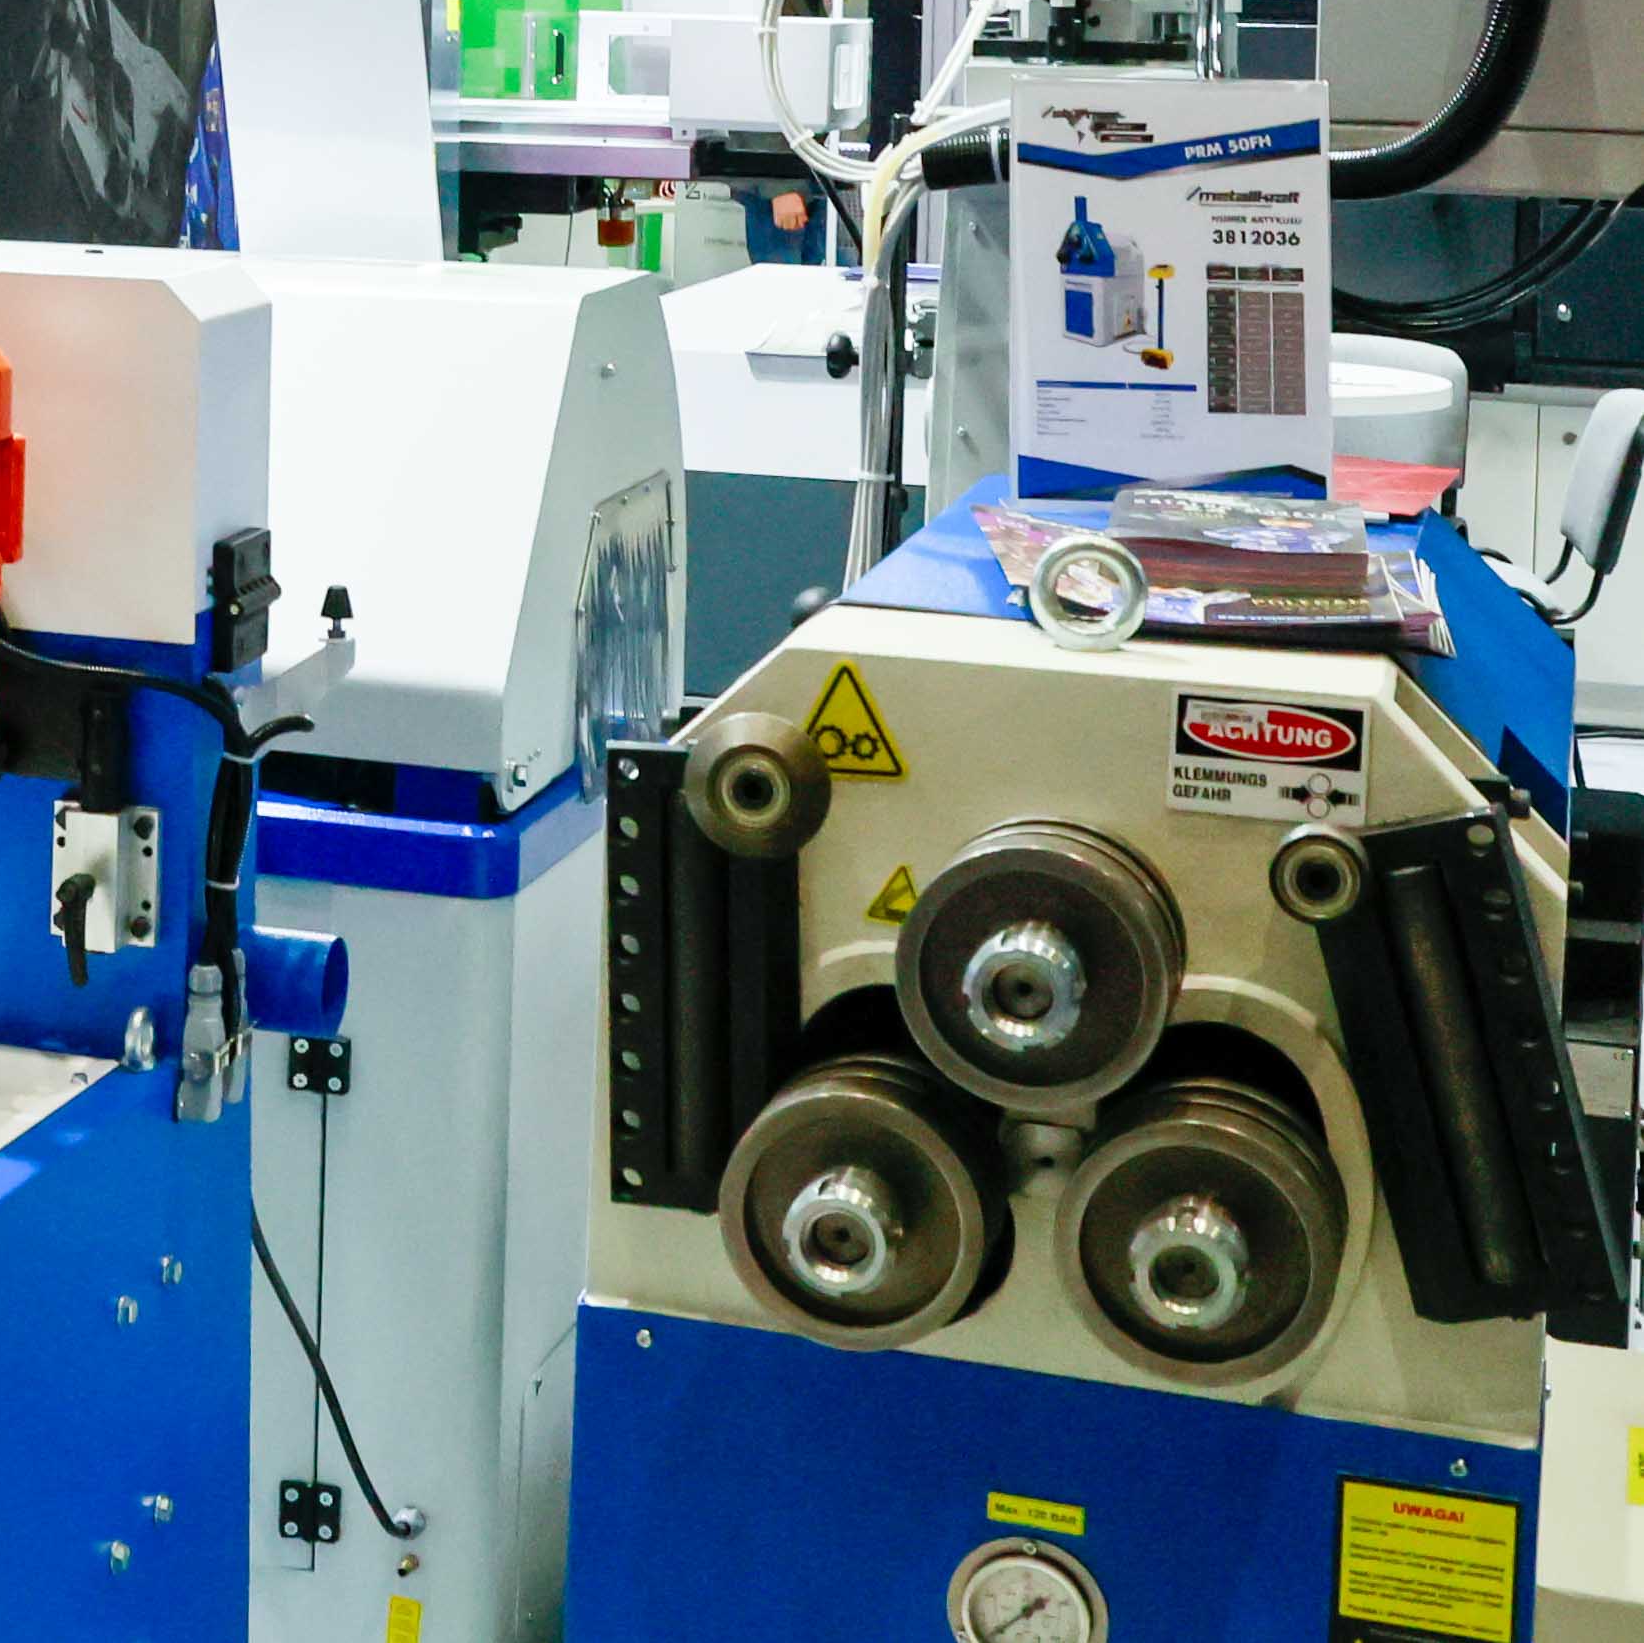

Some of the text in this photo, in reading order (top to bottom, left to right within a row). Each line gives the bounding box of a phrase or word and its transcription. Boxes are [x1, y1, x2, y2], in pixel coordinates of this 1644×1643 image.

[1184, 133, 1272, 160] PRM 50FH
[1212, 229, 1301, 247] 3812036
[1207, 721, 1333, 749] ACHTUNG
[1173, 766, 1268, 788] KLEMMUNGS
[1172, 785, 1231, 802] GEFAHR
[1392, 1501, 1465, 1524] UWAGA!
